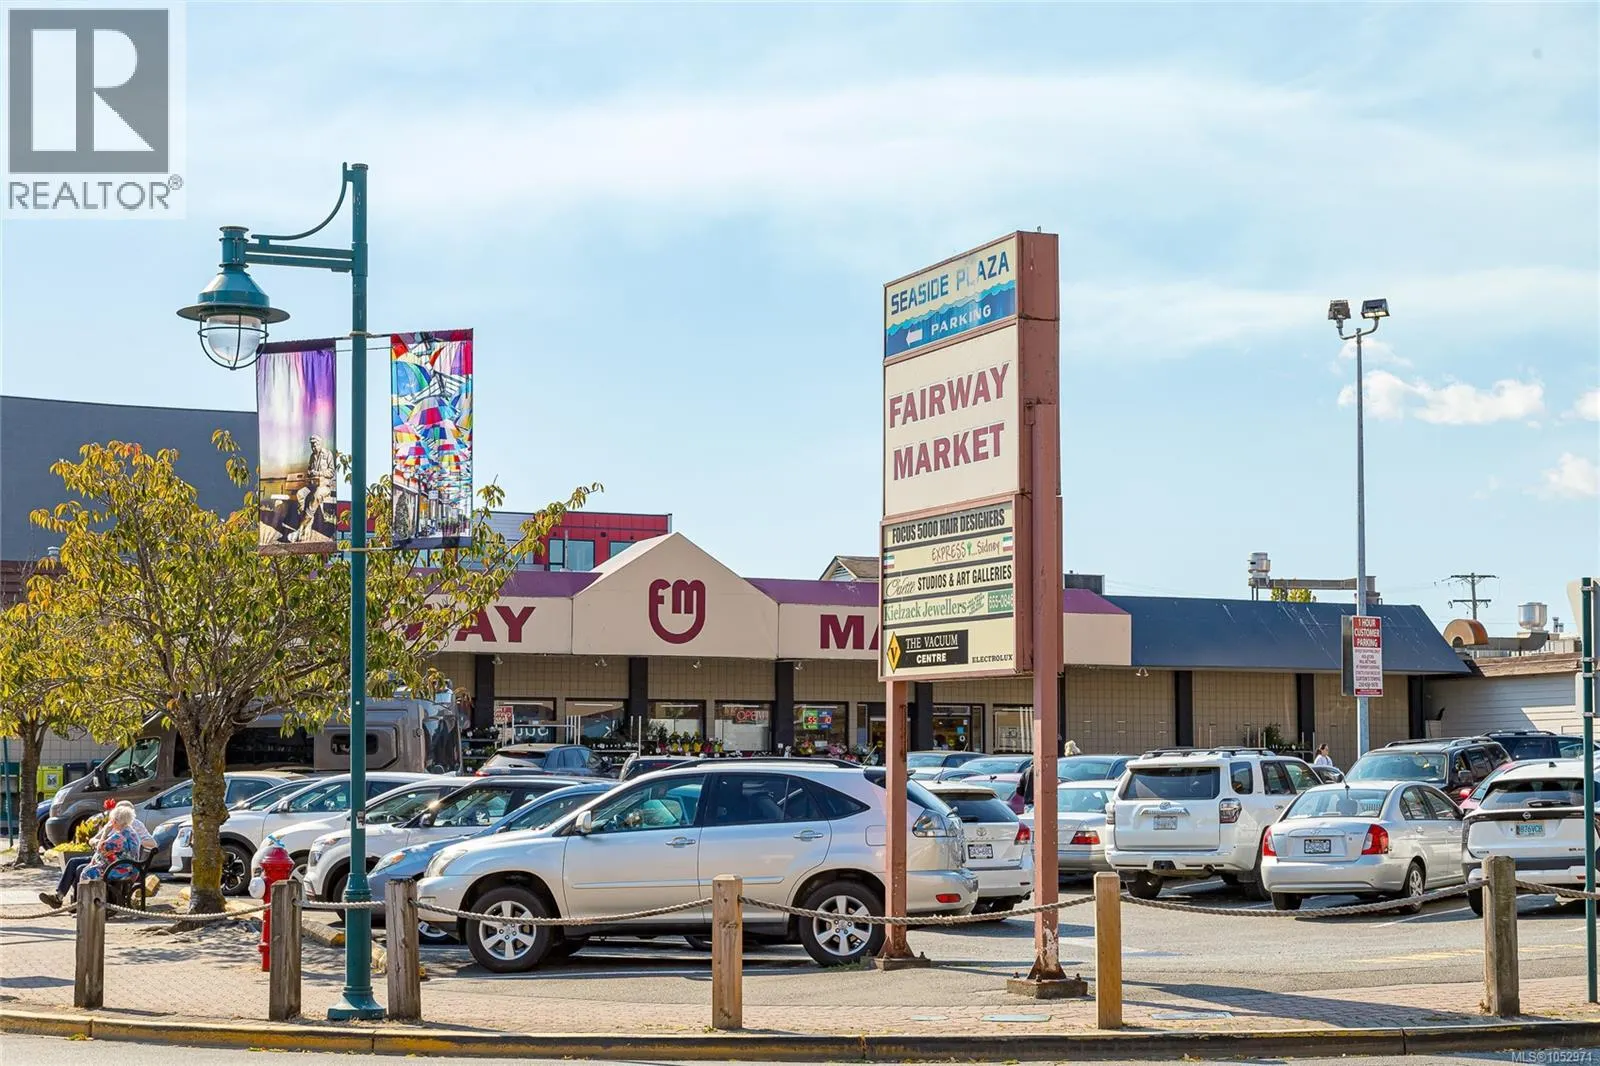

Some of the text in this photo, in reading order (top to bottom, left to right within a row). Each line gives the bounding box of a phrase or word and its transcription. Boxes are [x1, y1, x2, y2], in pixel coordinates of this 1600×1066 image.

[891, 274, 949, 315] SEASIDE
[931, 305, 991, 336] PARKING
[889, 361, 1010, 428] FAIRWAY
[893, 422, 1005, 480] MARKET
[892, 508, 1005, 544] FOCUS 5000 HAIR DESIGNERS
[931, 541, 966, 561] EXPRESS
[918, 574, 947, 591] STUDIOS
[949, 573, 954, 587] &
[956, 570, 971, 586] ART
[972, 564, 1012, 584] GALLERIES
[922, 598, 967, 618] Jewellers
[820, 614, 878, 650] M
[1354, 628, 1380, 637] CUSTOMER
[1361, 618, 1376, 627] HOUR
[905, 634, 958, 649] THE VACUUM
[1356, 638, 1378, 647] PARKING
[891, 647, 898, 663] V
[916, 653, 947, 664] CENTRE
[972, 654, 1013, 663] ELECTROLUX
